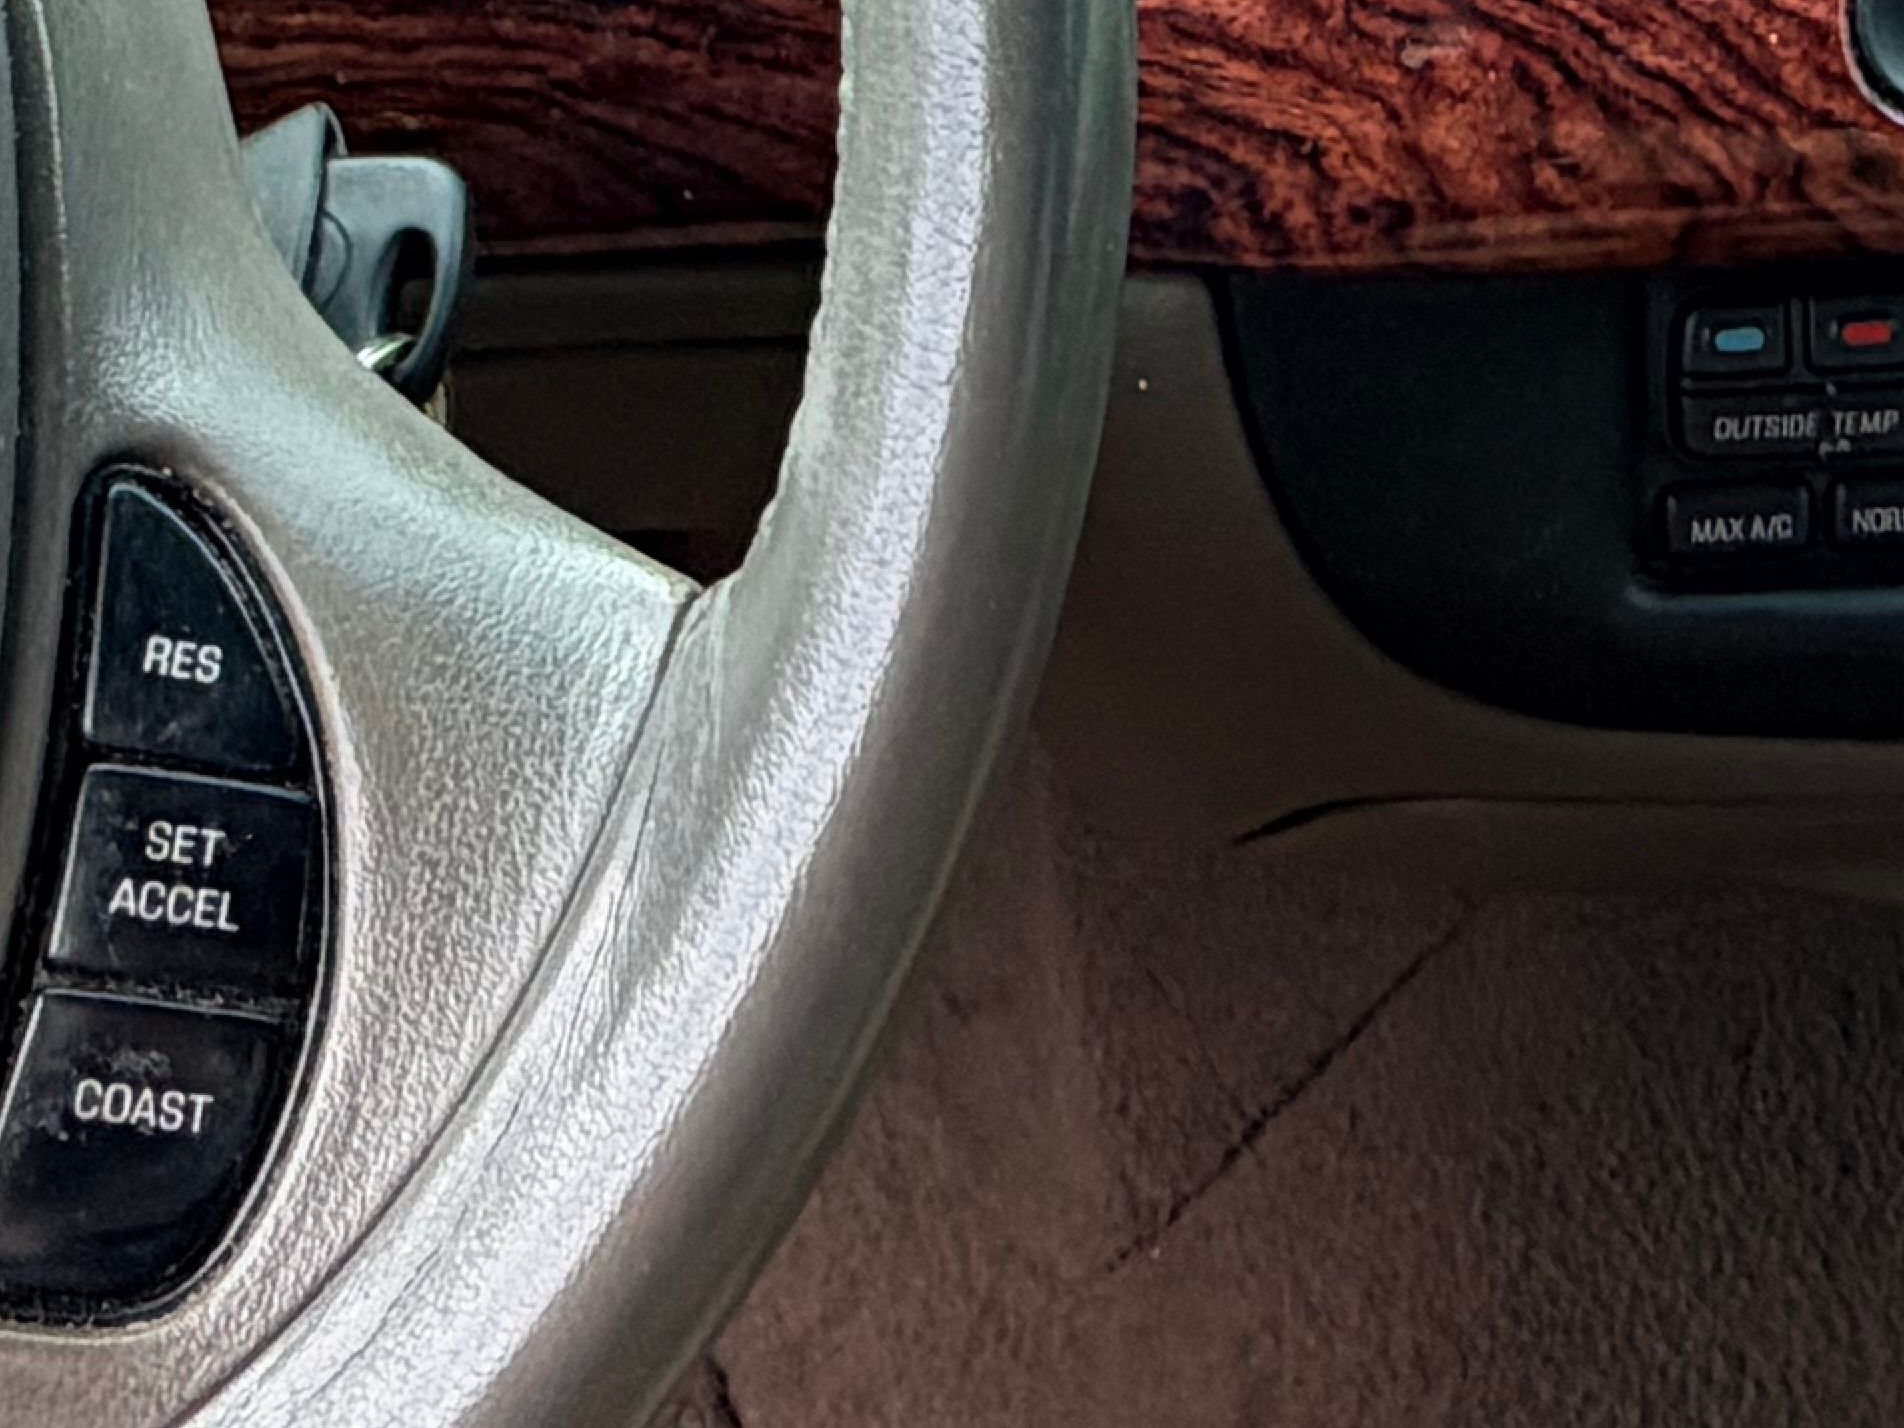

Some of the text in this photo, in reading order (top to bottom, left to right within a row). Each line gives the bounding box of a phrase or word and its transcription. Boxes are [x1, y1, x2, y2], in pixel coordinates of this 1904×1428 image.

[1714, 410, 1899, 439] OUTSIDE TEMP
[1690, 512, 1792, 544] MAX A/C
[142, 635, 223, 685] RES
[145, 820, 226, 869] SET
[107, 877, 240, 932] ACCEL
[73, 1078, 214, 1135] COAST
